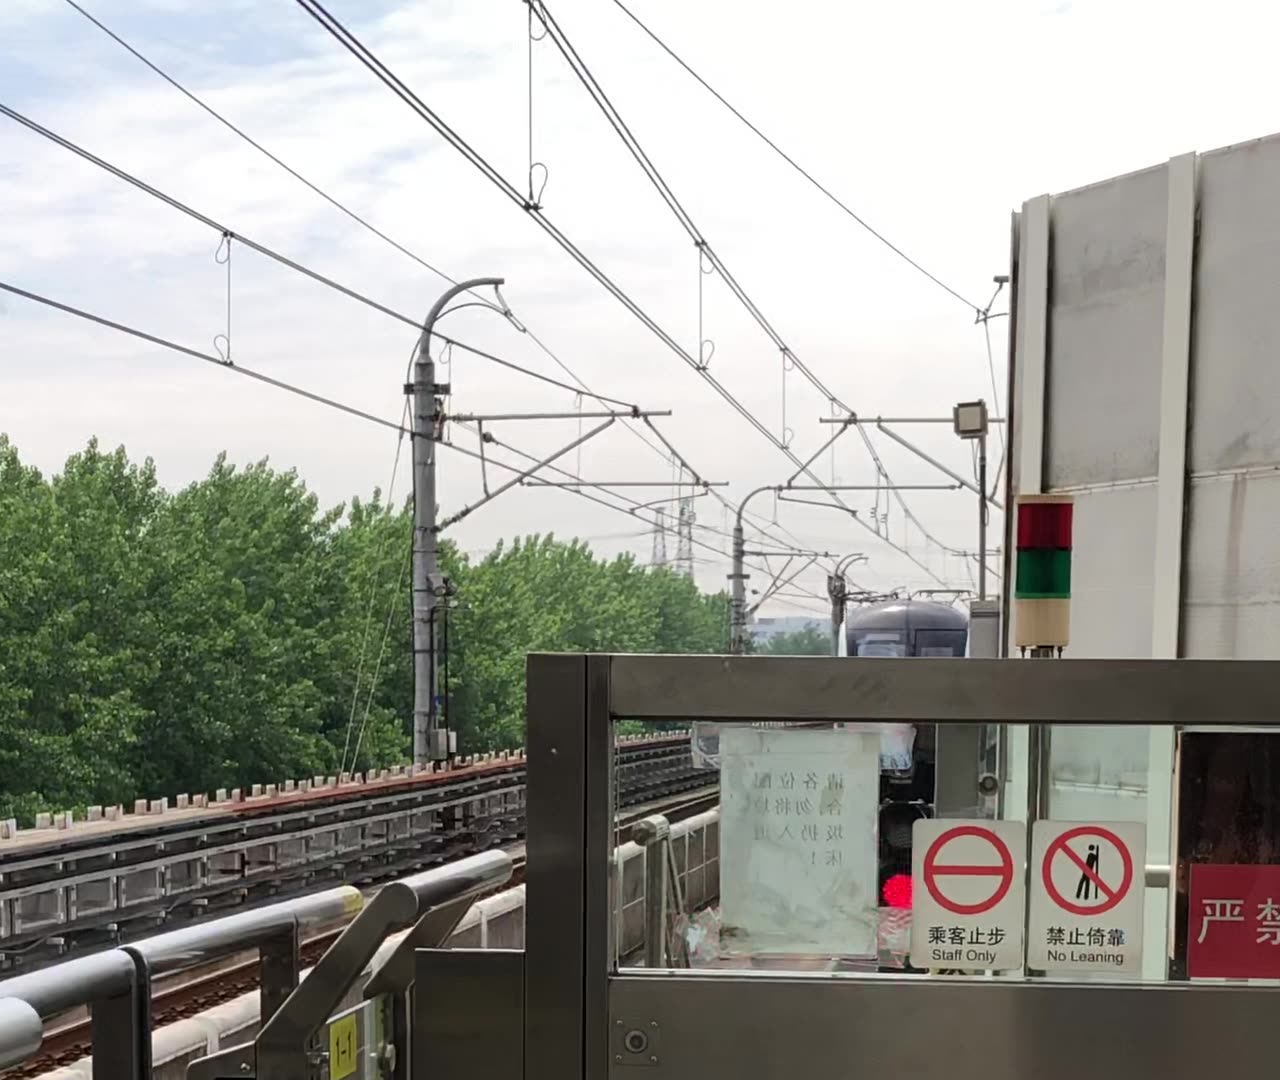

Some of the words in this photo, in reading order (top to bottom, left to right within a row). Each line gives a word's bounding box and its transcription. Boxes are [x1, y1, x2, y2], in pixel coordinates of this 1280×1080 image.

[928, 926, 1006, 946] 乘客止步
[1046, 926, 1125, 947] 禁止倚靠
[932, 949, 962, 962] Staff
[966, 949, 997, 964] Only
[1047, 949, 1067, 962] No
[1070, 950, 1125, 965] Leaning
[335, 1031, 352, 1067] 1-1
